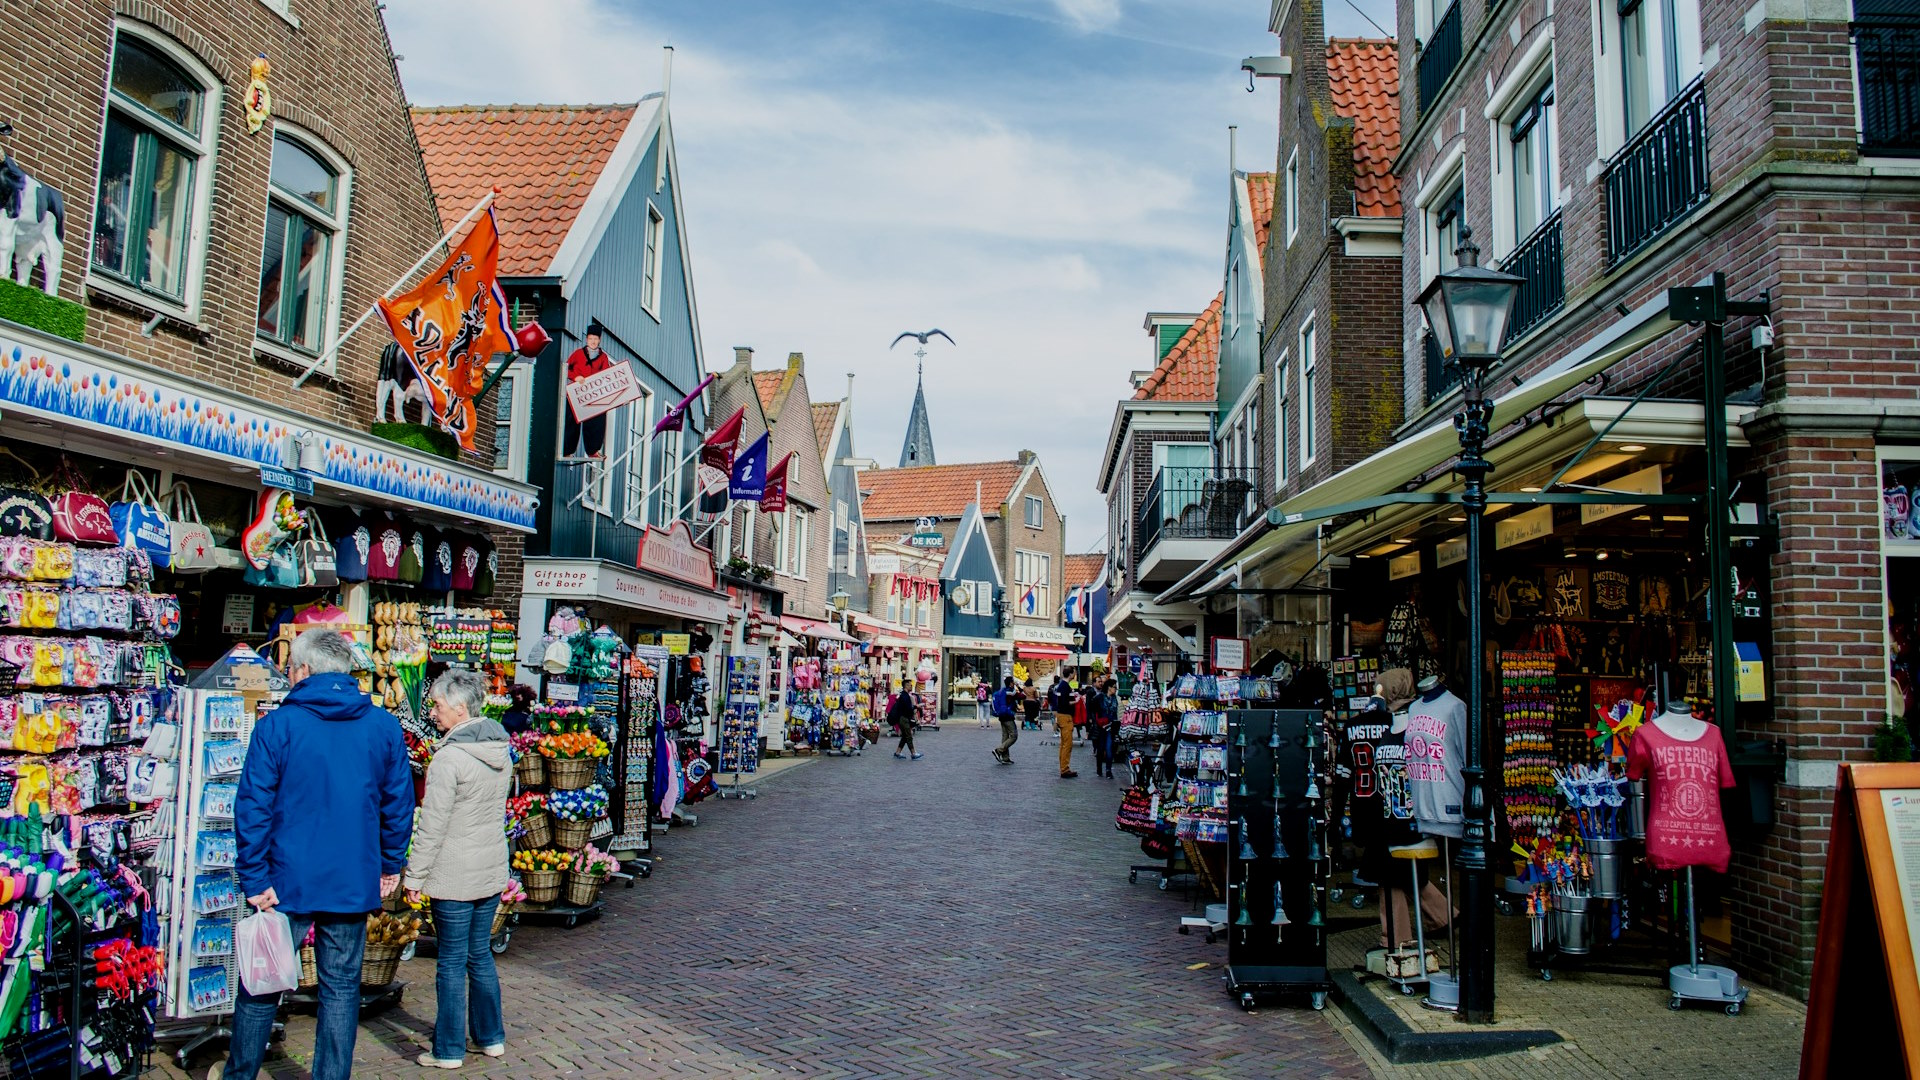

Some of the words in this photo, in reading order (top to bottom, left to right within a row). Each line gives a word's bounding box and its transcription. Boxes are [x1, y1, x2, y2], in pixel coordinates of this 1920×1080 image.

[574, 375, 612, 396] FOTO'S
[613, 368, 627, 379] IN
[577, 377, 630, 405] KOSTUUM
[263, 470, 295, 486] HEINEKEN
[296, 478, 312, 490] BLVD
[732, 487, 762, 496] Informatie
[912, 537, 923, 546] DE
[926, 537, 943, 546] KOE
[648, 540, 671, 566] FOTO'S
[672, 549, 680, 568] IN
[680, 552, 708, 579] KOSTUUM
[534, 570, 587, 580] Giftshop
[556, 580, 583, 588] Boer
[1593, 571, 1629, 585] AMSTERDAM
[616, 578, 645, 597] Souvenirs
[658, 588, 680, 605] Giftshop
[680, 594, 687, 605] de
[687, 596, 698, 608] Boer
[1025, 628, 1038, 637] Fish
[1045, 631, 1063, 640] Chips
[1351, 742, 1377, 798] 8
[1666, 763, 1711, 781] CITY
[1670, 821, 1692, 829] CAPITAL
